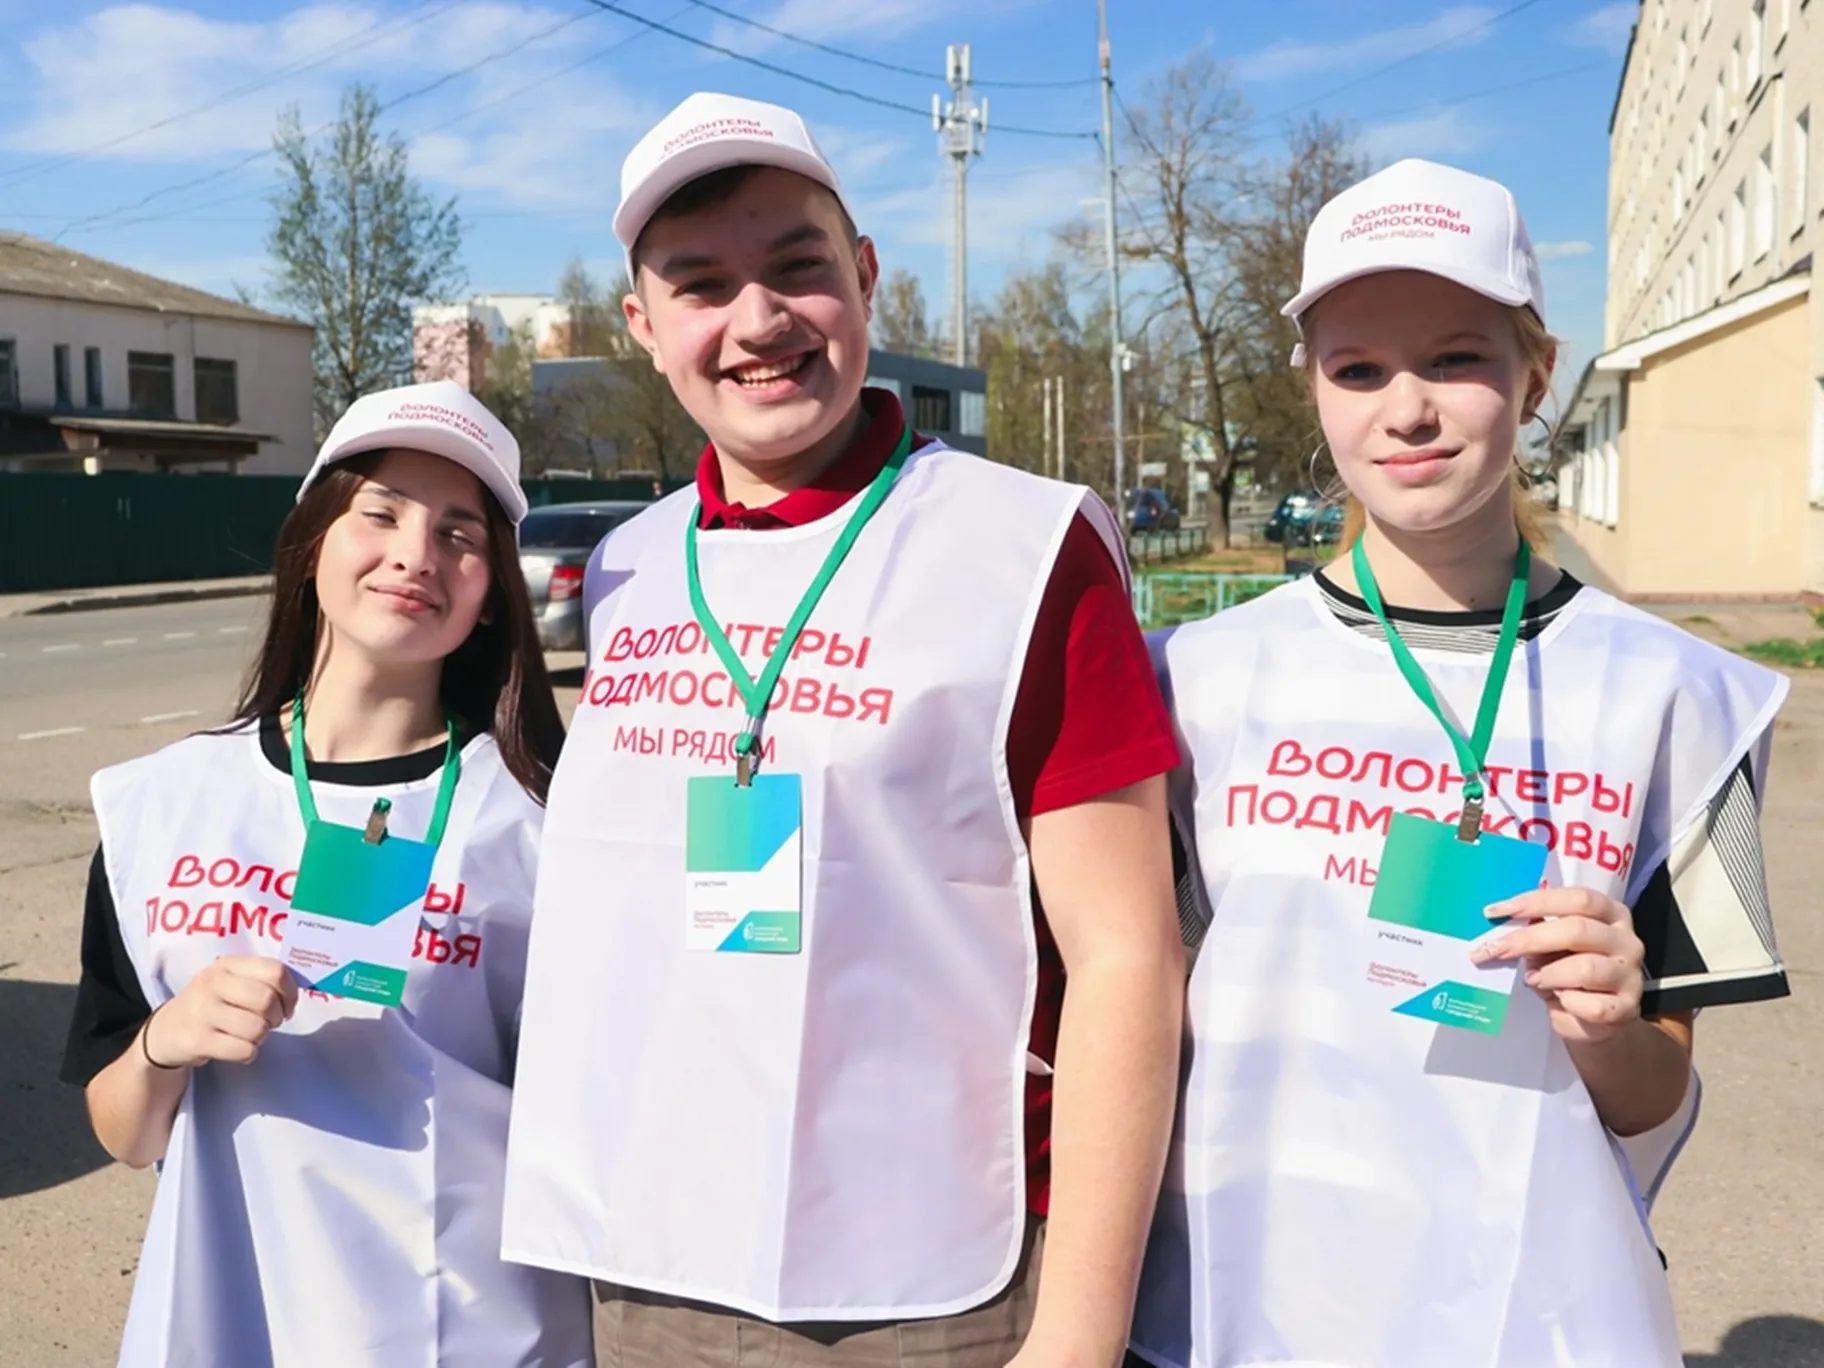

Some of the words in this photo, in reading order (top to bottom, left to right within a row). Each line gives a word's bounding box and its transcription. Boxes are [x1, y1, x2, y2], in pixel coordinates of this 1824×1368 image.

[1352, 203, 1460, 225] ВОЛОНТЕРЫ
[1340, 216, 1470, 242] ПОДМОСКОВЬЯ
[613, 725, 663, 755] МЫ
[1267, 740, 1632, 819] ВОЛОНТЕРЫ
[1378, 930, 1423, 946] участник
